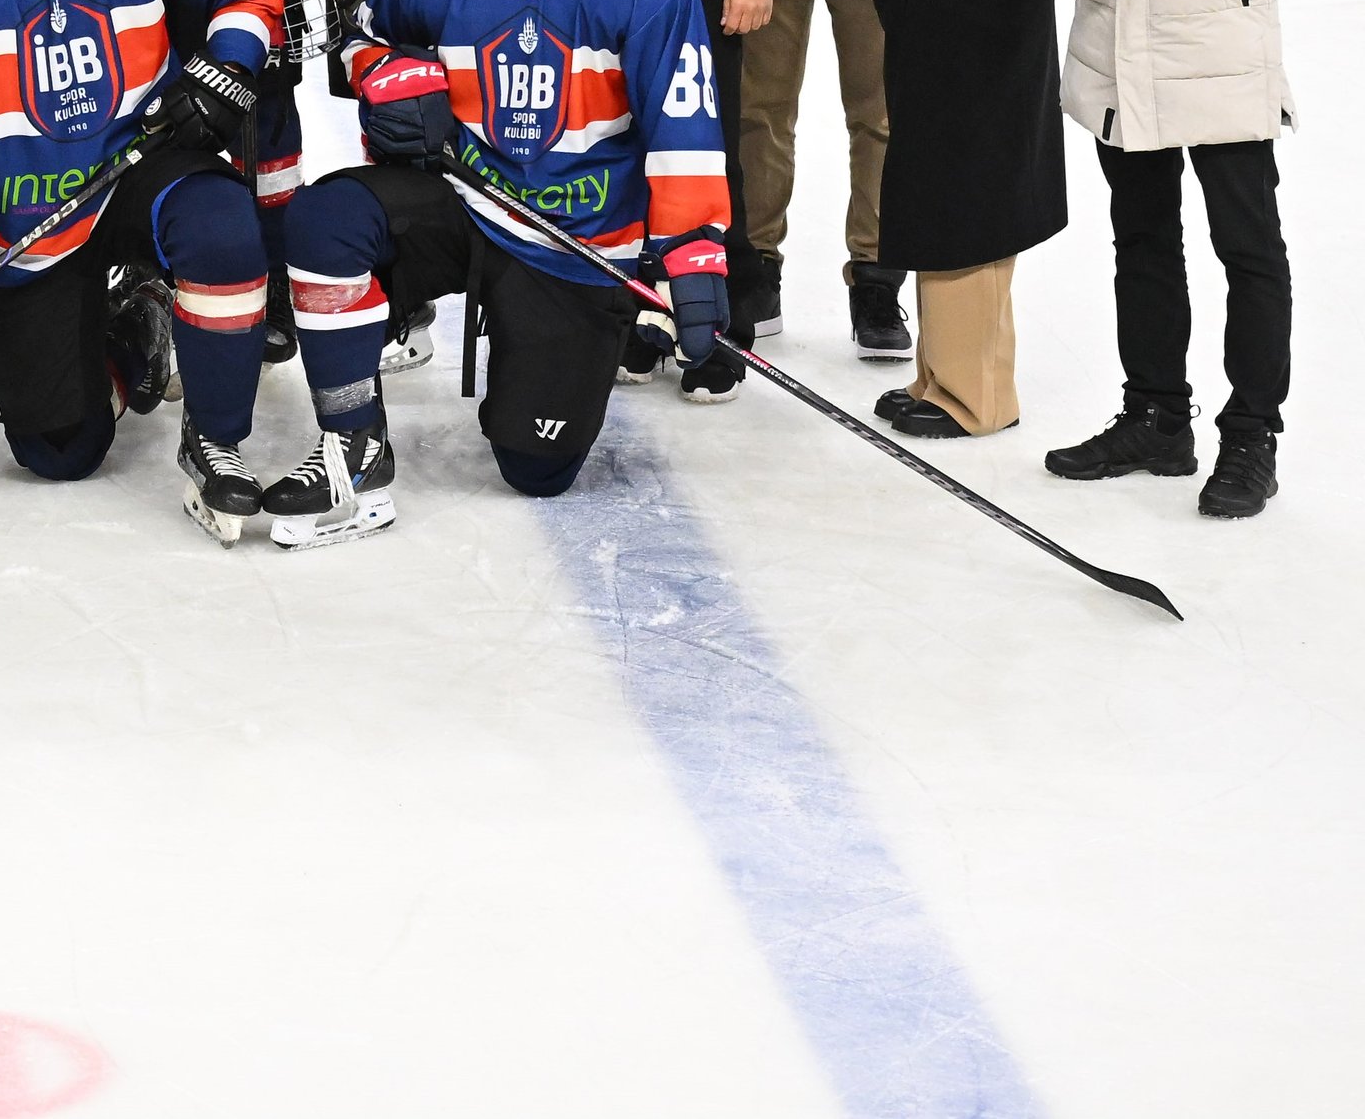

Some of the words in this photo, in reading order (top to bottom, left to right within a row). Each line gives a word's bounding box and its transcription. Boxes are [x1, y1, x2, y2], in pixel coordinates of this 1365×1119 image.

[183, 53, 258, 112] WARRIOR
[370, 63, 446, 91] TRU
[59, 87, 87, 104] SPOR
[513, 112, 538, 125] SPOR
